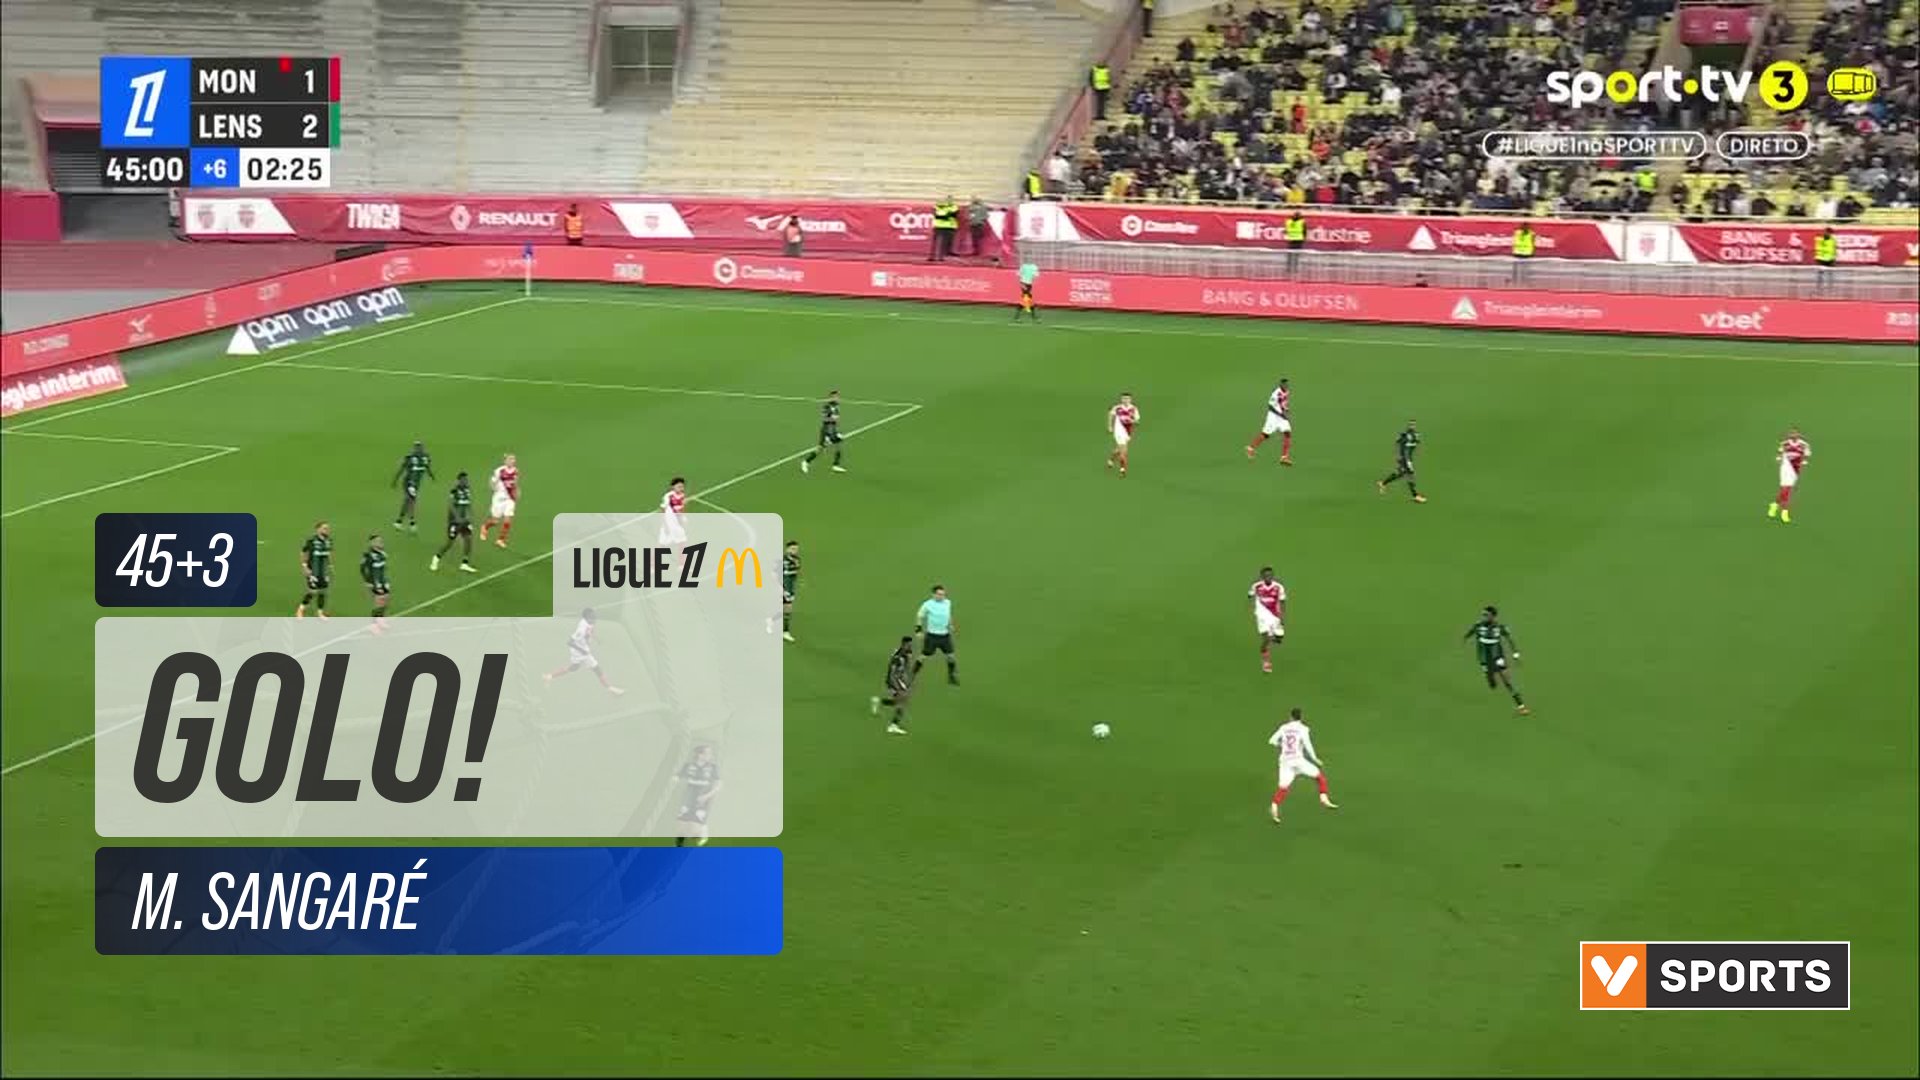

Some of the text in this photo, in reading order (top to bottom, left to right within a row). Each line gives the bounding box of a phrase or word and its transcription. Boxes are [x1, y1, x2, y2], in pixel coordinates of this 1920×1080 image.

[479, 212, 559, 227] RENAULT
[1720, 230, 1804, 247] BANG &
[1719, 247, 1804, 262] OLUFSEN
[1203, 288, 1359, 312] BANG & OLUFSEN
